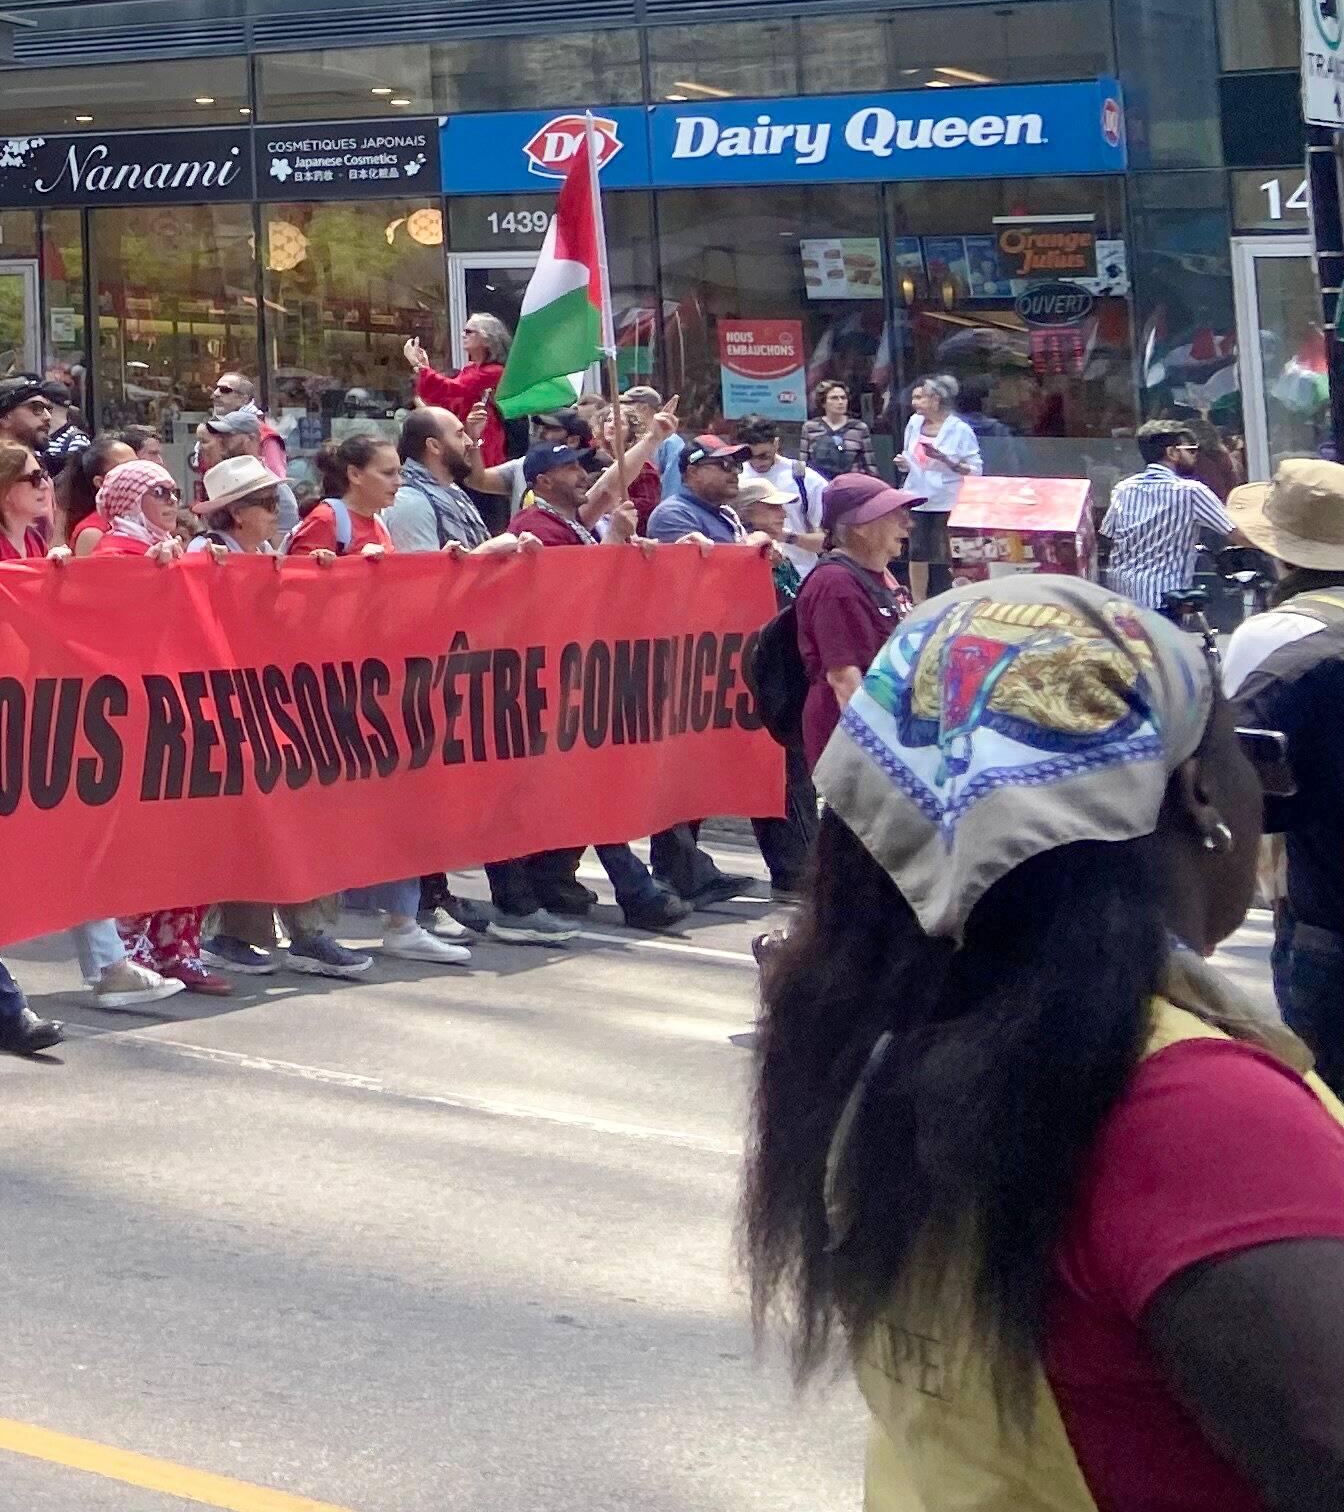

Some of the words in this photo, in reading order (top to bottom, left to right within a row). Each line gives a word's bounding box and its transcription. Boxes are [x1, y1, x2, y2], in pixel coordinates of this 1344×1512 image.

[267, 138, 357, 153] COSMÉTIQUES
[361, 135, 426, 149] JAPONAIS
[672, 115, 831, 165] Dairy
[844, 107, 1043, 157] Queen
[34, 144, 241, 193] Nanami
[294, 156, 343, 170] Japanese
[343, 153, 398, 166] Cosmetics
[487, 210, 548, 234] 1439
[999, 228, 1092, 253] Orange
[1019, 294, 1086, 315] OUVERT
[726, 332, 754, 343] NOUS
[727, 345, 795, 356] EMBAUCHONS
[140, 656, 399, 802] REFUSONS
[402, 631, 547, 771] D'ÊTRE
[557, 631, 764, 753] COMPLICES
